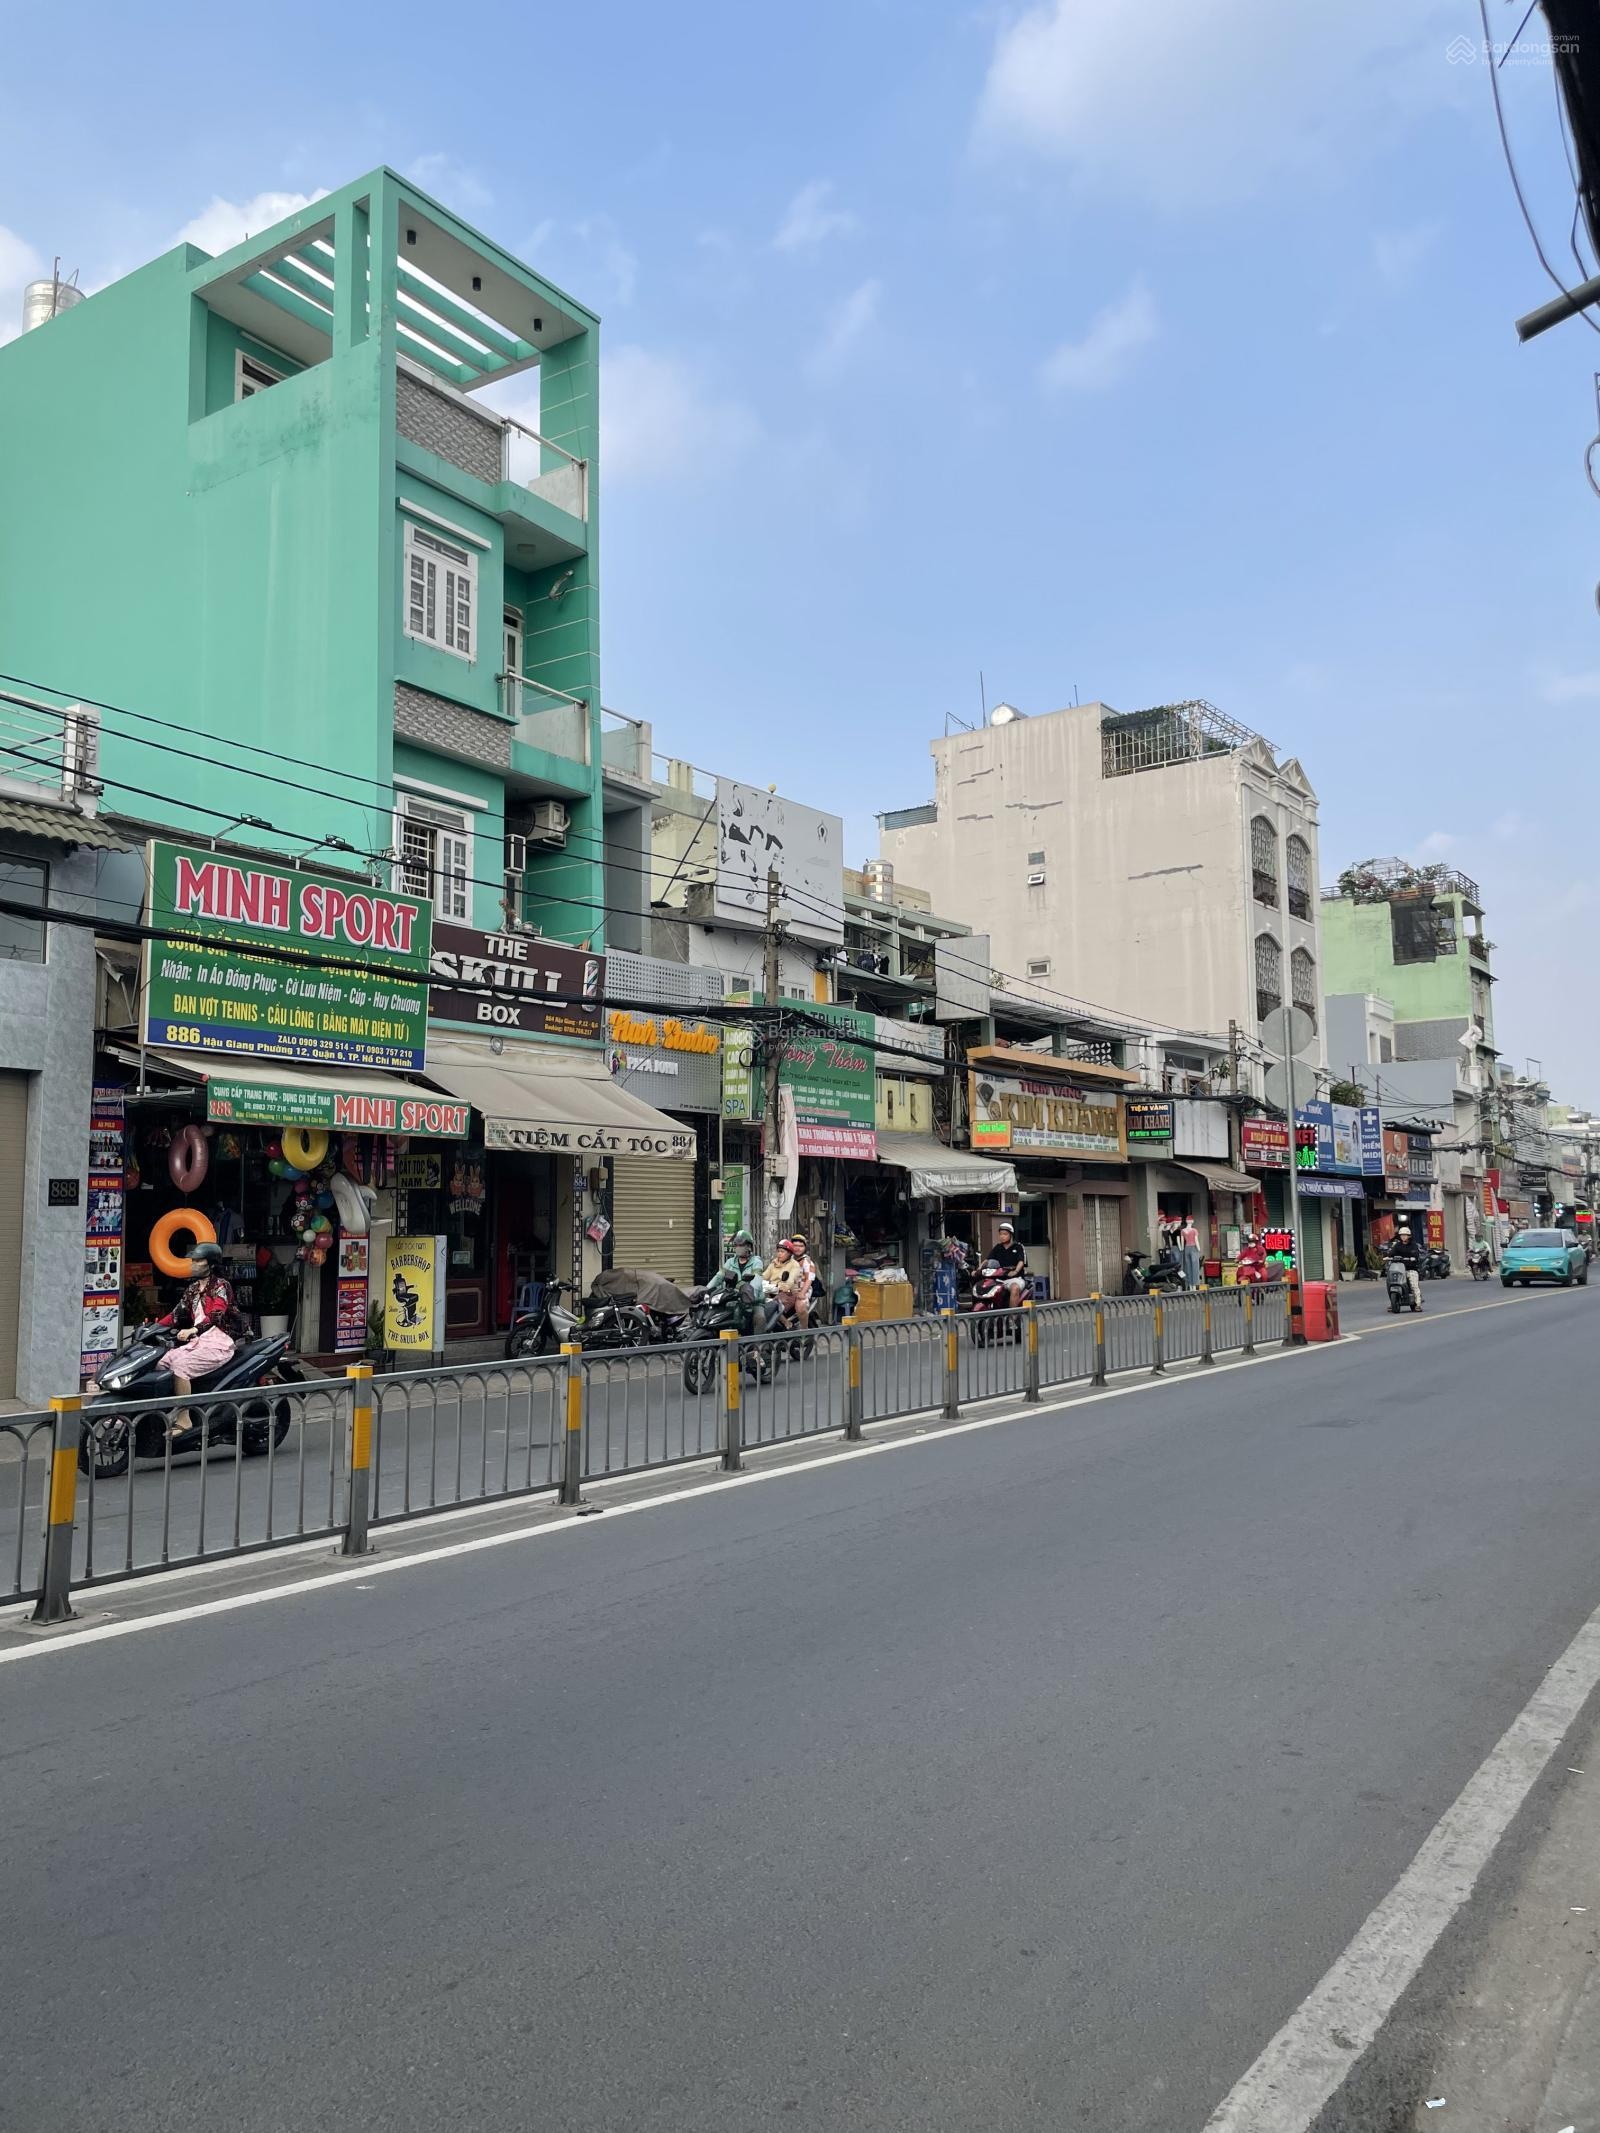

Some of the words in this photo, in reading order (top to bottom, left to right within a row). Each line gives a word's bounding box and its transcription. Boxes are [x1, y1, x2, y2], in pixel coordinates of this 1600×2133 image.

[175, 856, 292, 931] MINH
[300, 884, 419, 953] SPORT
[484, 935, 529, 961] THE
[197, 964, 207, 982] In
[209, 963, 223, 985] Áo
[225, 968, 251, 991] Đồng
[252, 973, 277, 996] Phục
[286, 977, 299, 996] Cờ
[300, 980, 317, 999] Lưu
[318, 983, 342, 1005] Niệm
[349, 988, 366, 1007] Cúp
[373, 991, 390, 1010] Huy
[390, 994, 421, 1015] Chương
[174, 994, 196, 1014] ĐAN
[200, 996, 219, 1020] VỢT
[222, 1000, 258, 1022] TENNIS
[268, 1002, 287, 1026] CẦU
[289, 1006, 314, 1029] LÔNG
[323, 1008, 348, 1033] BẰNG
[350, 1015, 369, 1036] MÁY
[477, 1002, 521, 1026] BOX
[166, 1025, 201, 1044] 886
[203, 1037, 223, 1048] Hậu
[226, 1039, 255, 1051] Giang
[257, 1042, 293, 1055] Phường
[312, 1049, 335, 1060] Quận
[362, 1054, 374, 1063] Hồ
[392, 1058, 412, 1067] Minh
[278, 1035, 297, 1044] ZALO
[299, 1038, 318, 1047] 0909
[319, 1040, 334, 1049] 329
[335, 1041, 349, 1050] 514
[366, 1046, 384, 1055] 0903
[385, 1048, 398, 1057] 757
[400, 1050, 413, 1058] 210
[213, 1086, 230, 1098] CUNG
[231, 1085, 243, 1098] CẤP
[244, 1088, 262, 1100] TRANG
[263, 1090, 278, 1103] PHỤC
[282, 1092, 298, 1104] DỤNG
[298, 1094, 306, 1106] CỤ
[307, 1092, 317, 1105] THỂ
[318, 1096, 331, 1106] THAO
[726, 1099, 746, 1114] SPA
[333, 1095, 397, 1129] MINH
[401, 1101, 469, 1135] SPORT
[999, 1093, 1044, 1131] KIM
[1144, 1111, 1170, 1129] KHÁNH
[509, 1127, 570, 1150] TIỆM
[577, 1129, 620, 1150] CẮT
[627, 1136, 668, 1153] TÓC
[1362, 1151, 1381, 1159] MIDI
[51, 1181, 77, 1198] 888
[401, 1177, 422, 1188] NAM
[575, 1176, 587, 1187] 884
[390, 1254, 431, 1273] BARBERSHOP
[387, 1329, 399, 1342] THE
[400, 1333, 417, 1344] SKULL
[418, 1330, 430, 1341] BOX
